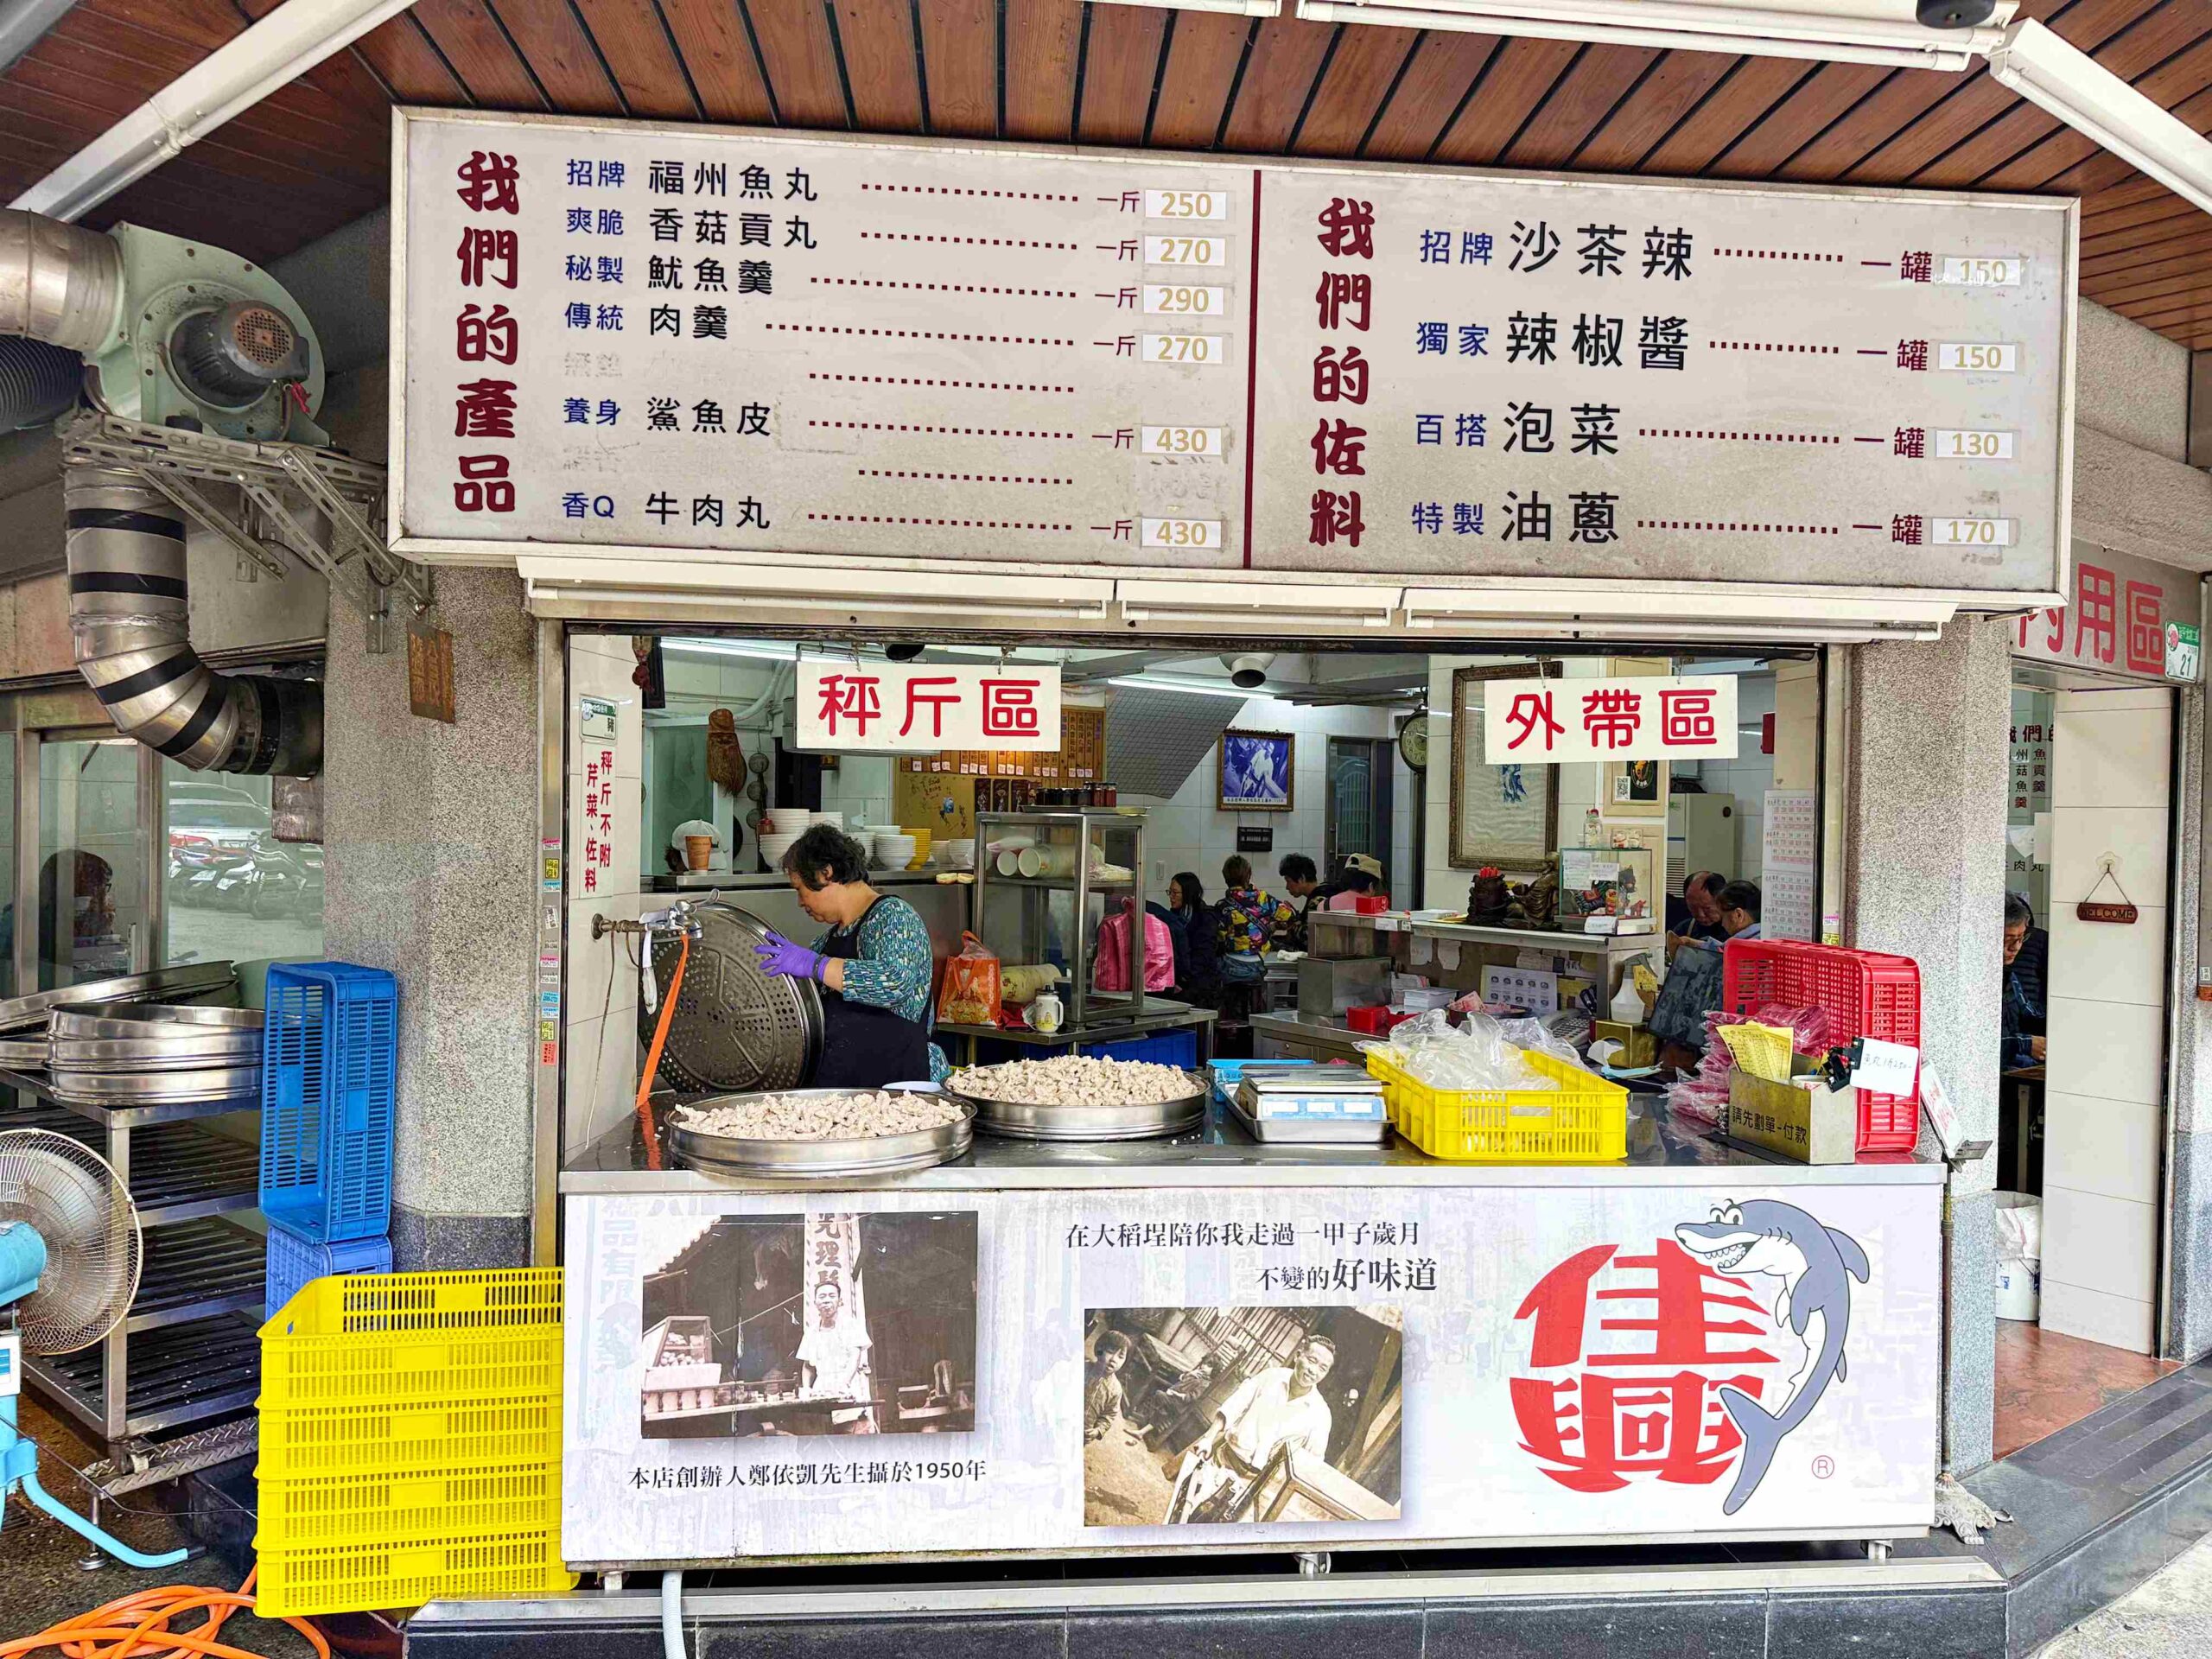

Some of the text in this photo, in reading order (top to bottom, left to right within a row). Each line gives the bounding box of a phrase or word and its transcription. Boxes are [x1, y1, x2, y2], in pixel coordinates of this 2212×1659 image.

[566, 158, 1212, 218] 招牌 福州魚丸 一斤 250
[566, 208, 1211, 264] 爽脆 香菇貢丸 一斤 270
[1420, 220, 2006, 283] 招牌 沙茶辣 一罐 150
[565, 255, 1210, 314] 秘製 魷魚羹 一斤 290
[453, 150, 520, 513] 我們的產品
[564, 302, 1209, 362] 傳統 肉羹 一斤 270
[1416, 310, 2002, 372] 獨家 辣椒醬 一罐 150
[1308, 197, 1375, 547] 我們的佐料
[563, 397, 1207, 454] 養身 鯊魚皮 一斤 430
[1415, 401, 1999, 459] 百搭 泡菜 一罐 130
[562, 491, 1207, 546] 香Q 牛肉丸 一斤 430
[1412, 490, 1995, 545] 特製 油蔥 一罐 170
[2180, 654, 2192, 677] 21
[818, 673, 1041, 737] 秤斤區
[1505, 689, 1719, 751] 外帶區
[585, 763, 598, 893] 芹菜、佐料
[599, 750, 613, 868] 秤斤不附
[1065, 1221, 1420, 1249] 在大稻埕陪你我走過一甲子歲月
[1255, 1257, 1438, 1293] 不變的好味道
[628, 1459, 988, 1491] 本店創辦人鄭依凱先生攝於1950年
